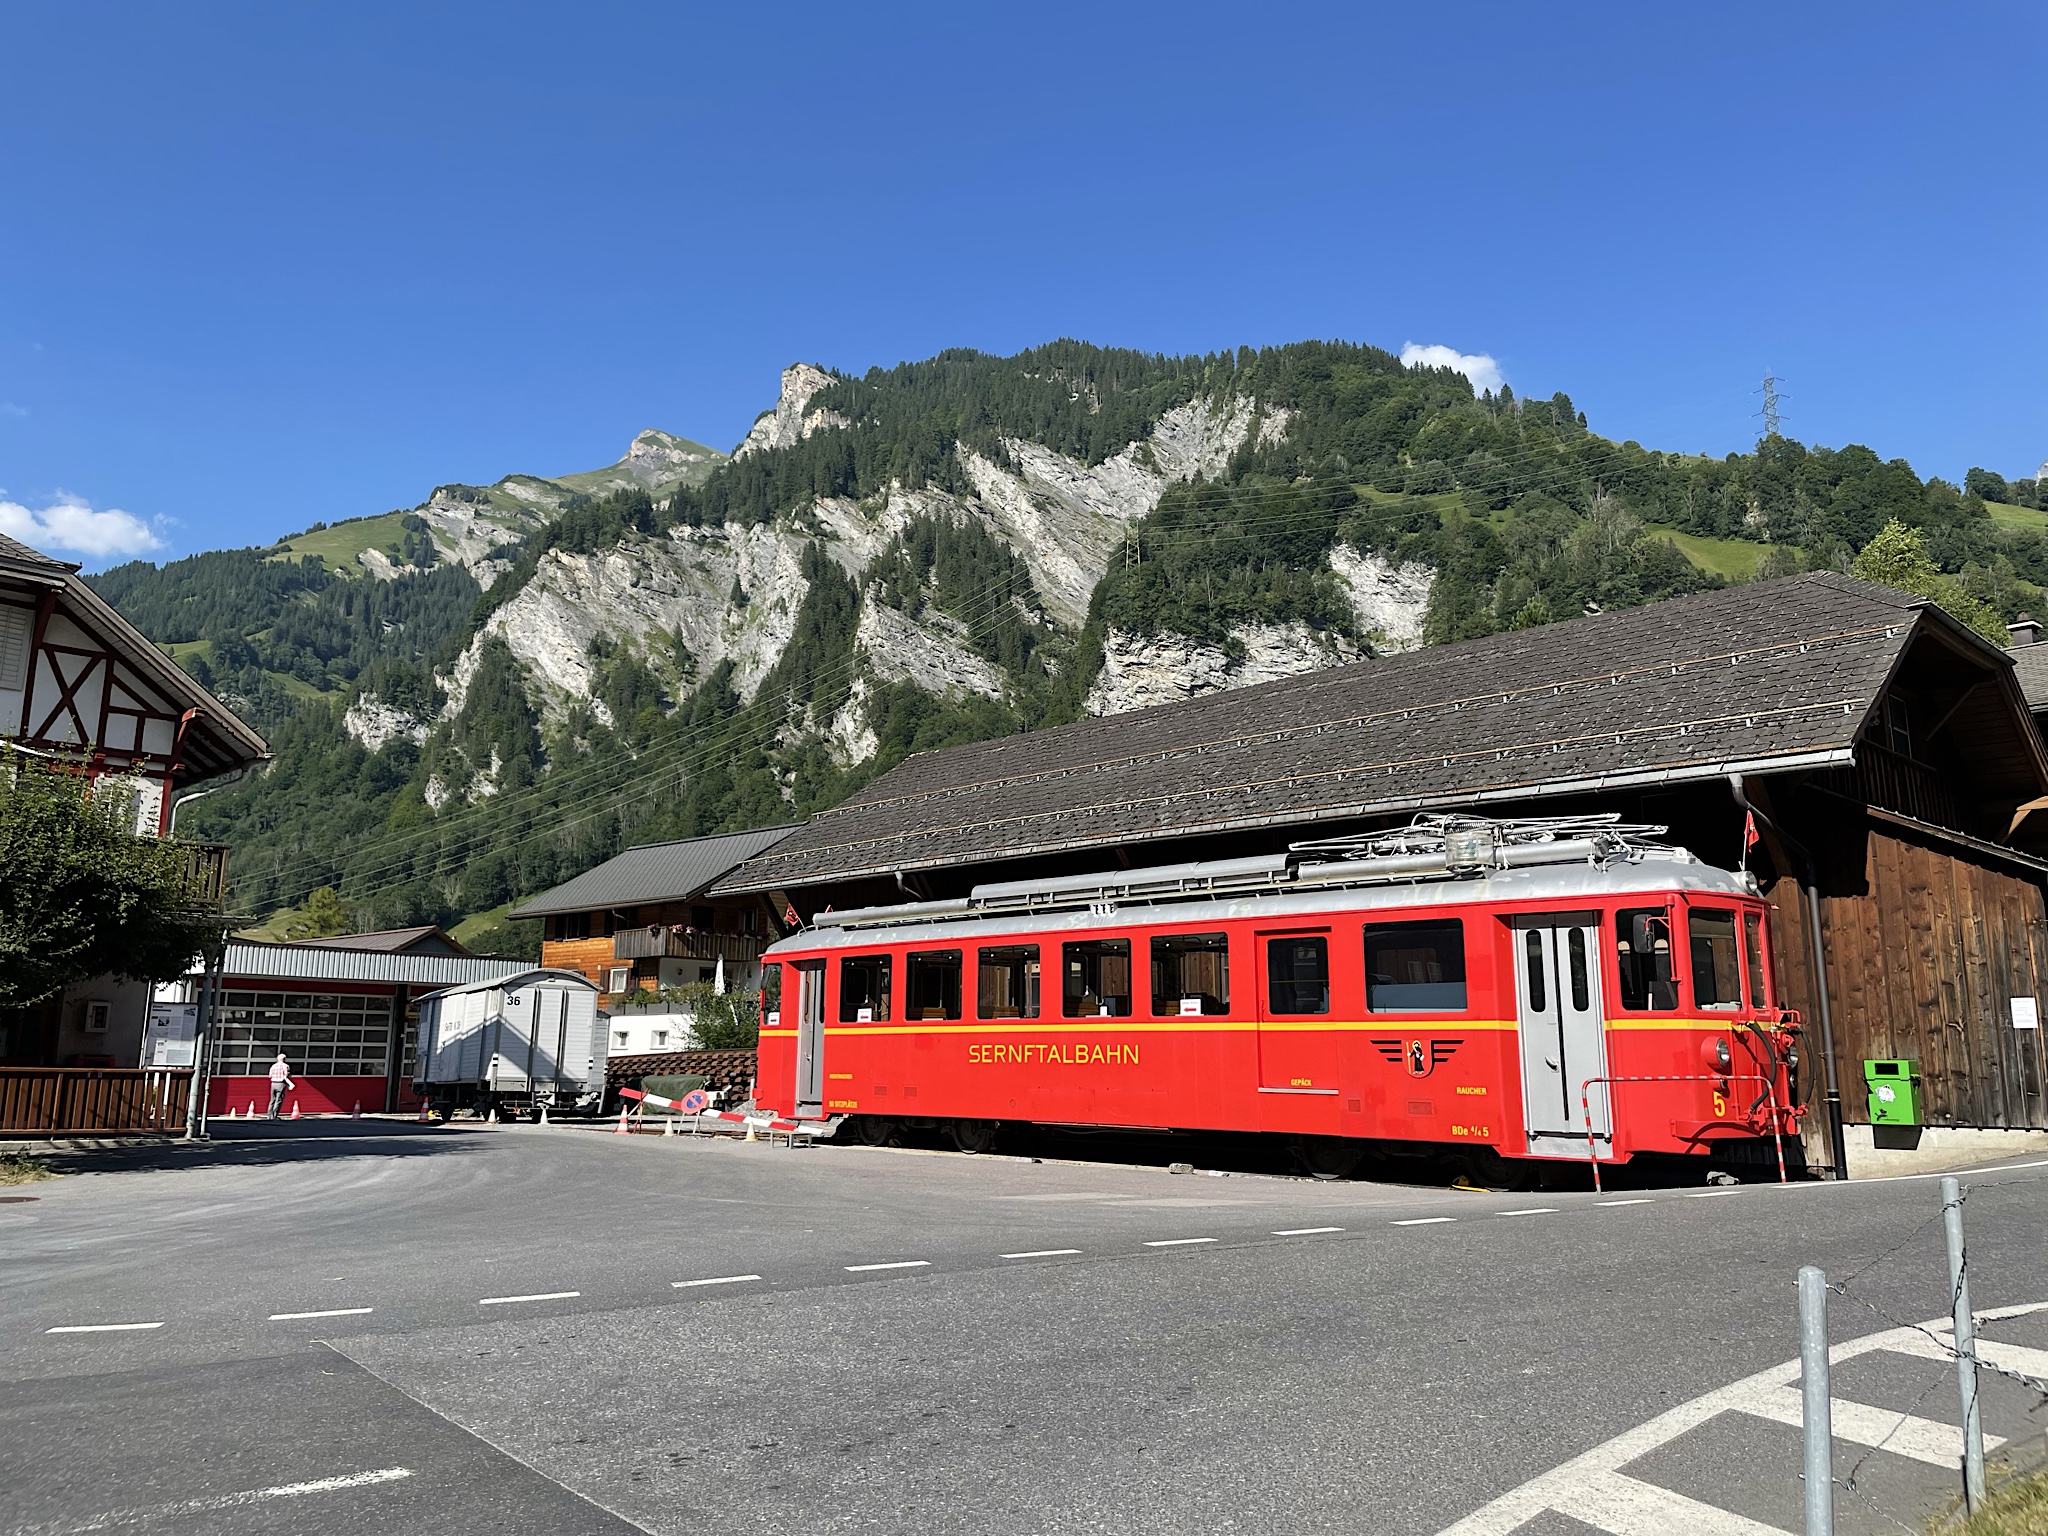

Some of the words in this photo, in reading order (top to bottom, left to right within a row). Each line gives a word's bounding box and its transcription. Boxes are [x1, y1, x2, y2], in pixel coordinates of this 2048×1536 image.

[507, 996, 521, 1006] 36
[968, 1044, 1139, 1064] SERNFTALBAHN
[1291, 1078, 1312, 1086] GEPÄCK
[1456, 1086, 1487, 1095] RAUCHER
[1713, 1091, 1726, 1117] 5
[1452, 1125, 1469, 1136] BDe
[1482, 1126, 1489, 1137] 5
